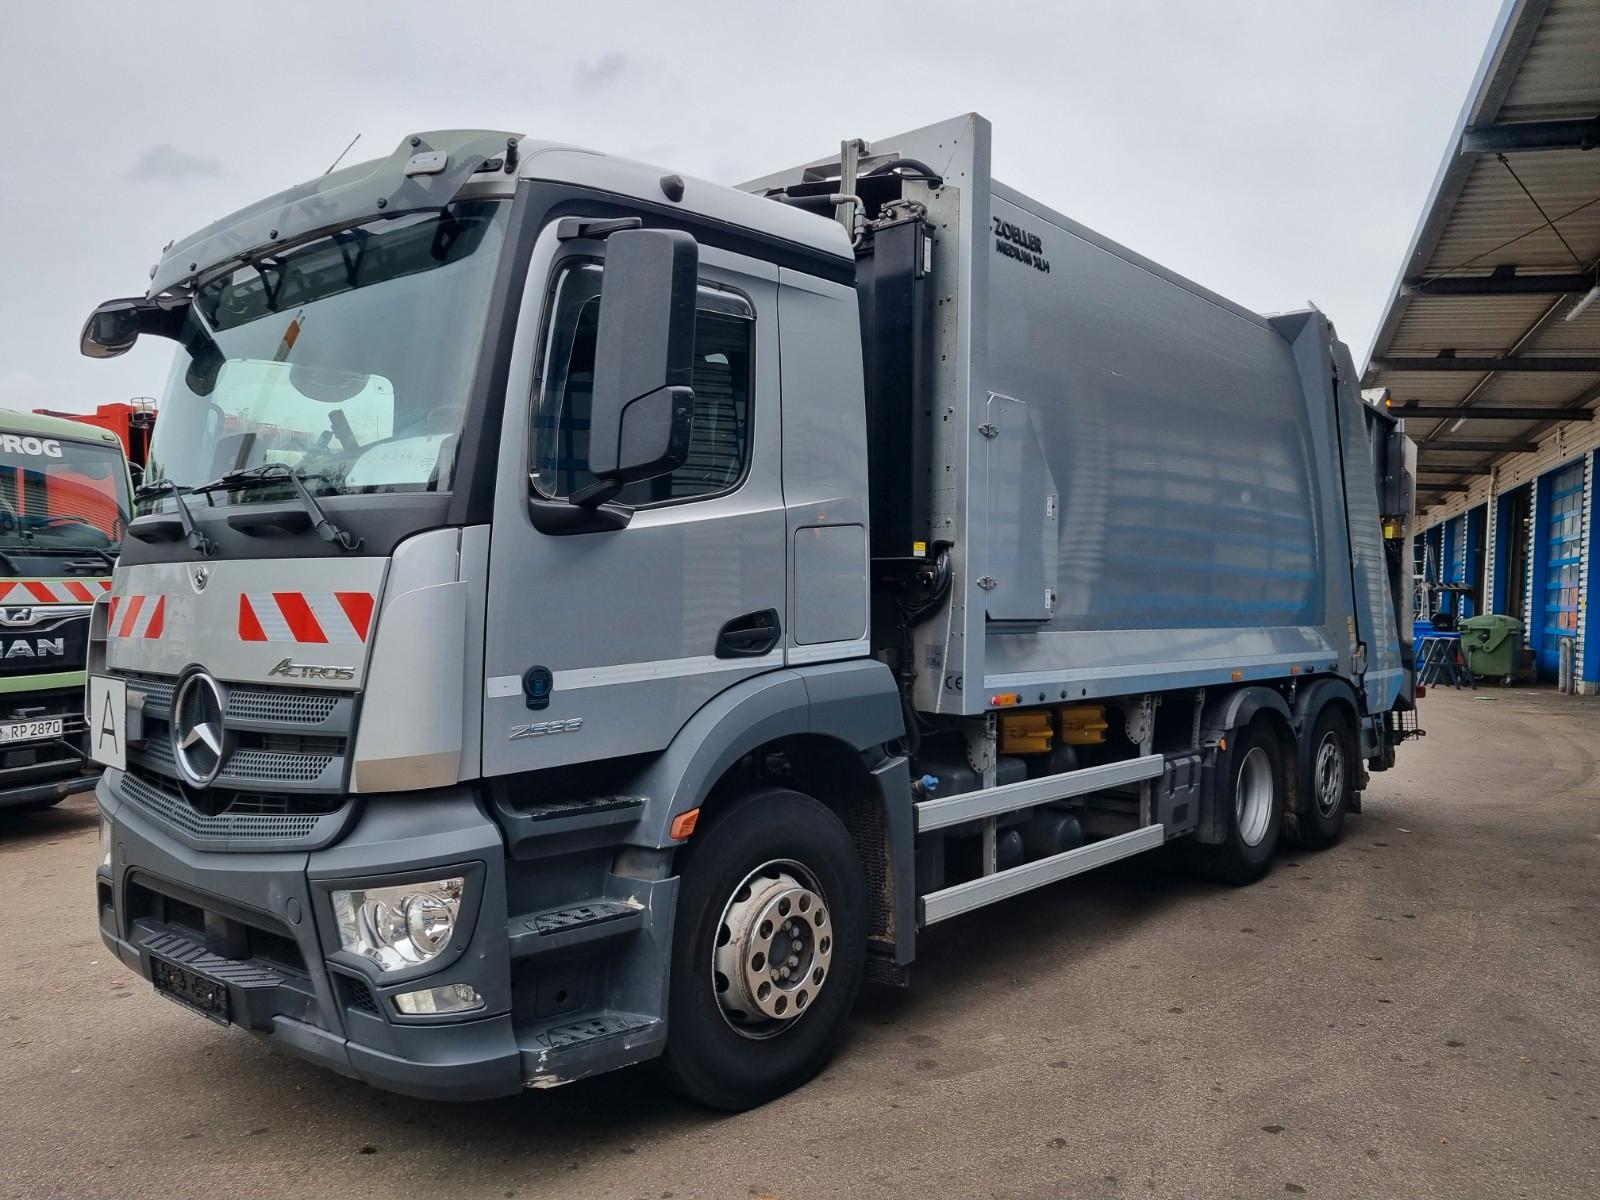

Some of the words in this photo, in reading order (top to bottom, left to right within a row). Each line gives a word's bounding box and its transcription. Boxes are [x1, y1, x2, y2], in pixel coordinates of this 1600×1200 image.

[993, 216, 1043, 255] ZOELLER
[996, 239, 1032, 266] MEDIUM
[0, 433, 63, 458] ROG
[0, 637, 64, 659] AN
[268, 656, 355, 680] ACTROS
[945, 675, 964, 691] CE
[11, 725, 28, 739] RP
[30, 721, 60, 736] 2870
[98, 689, 119, 755] A
